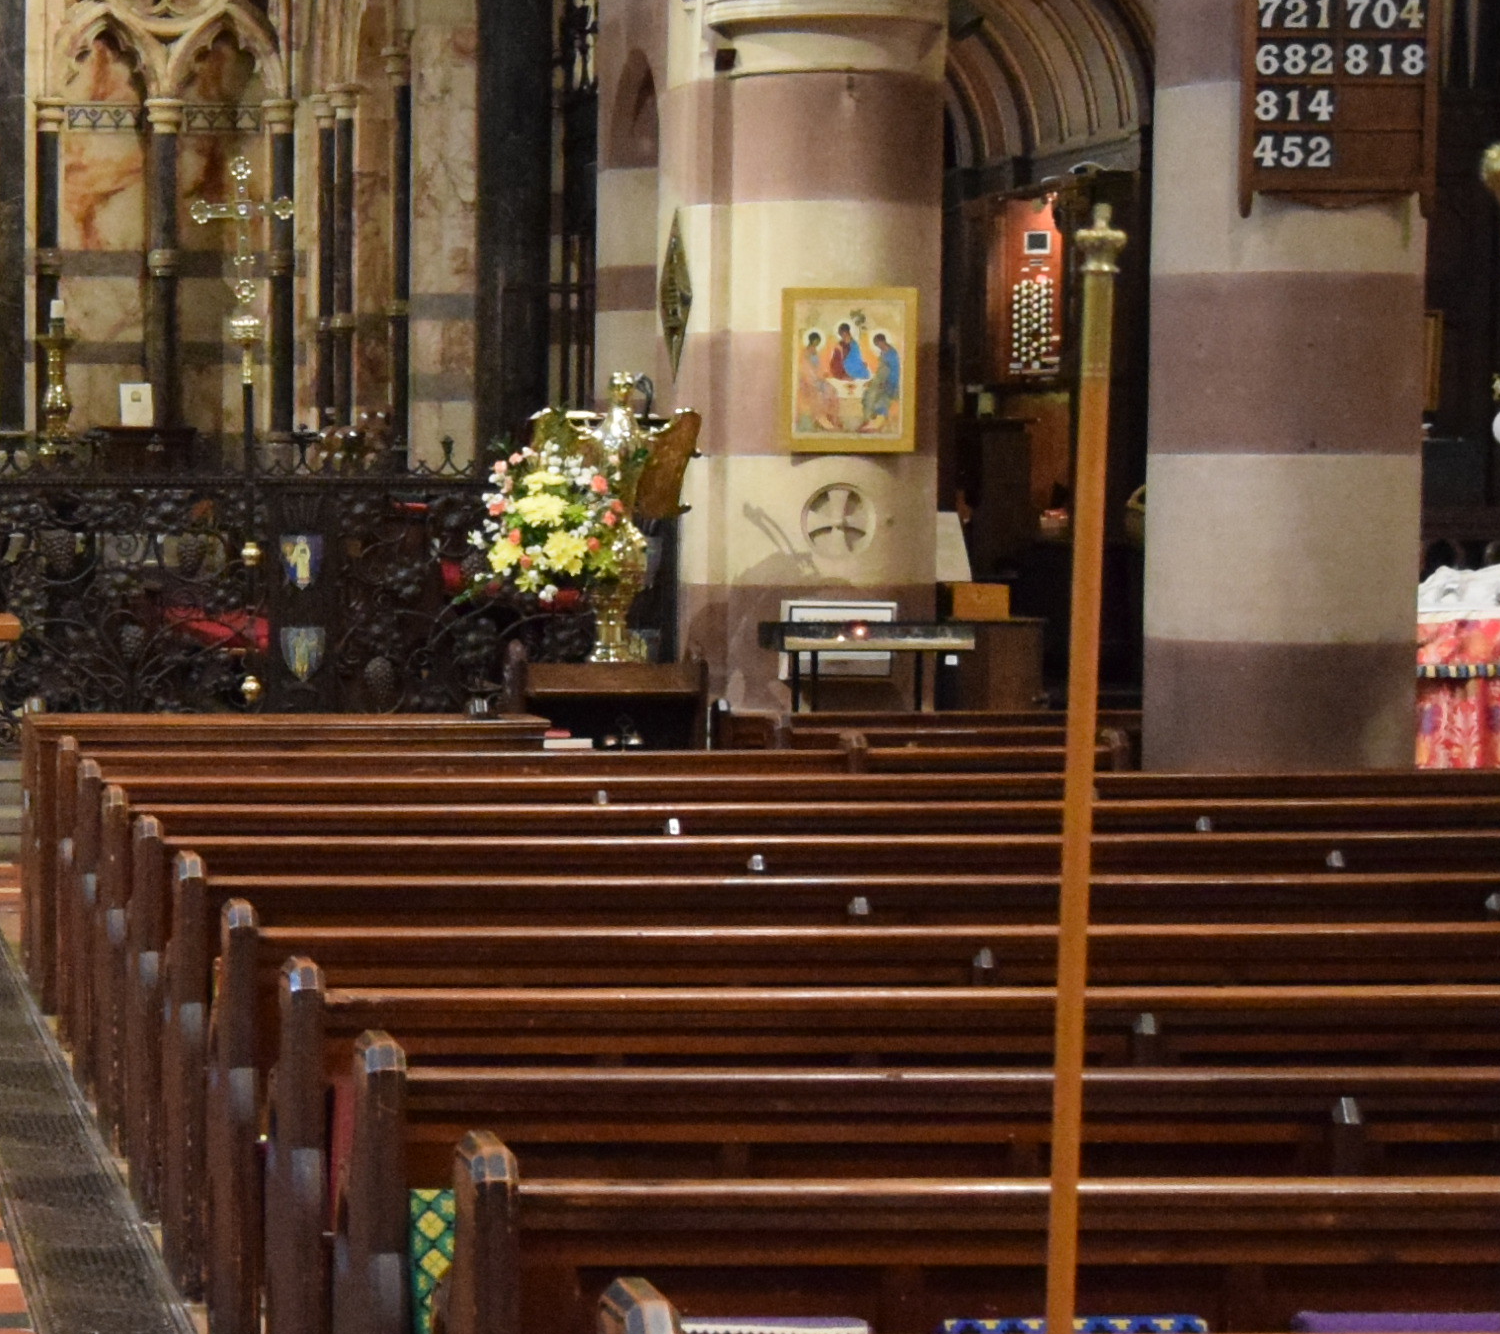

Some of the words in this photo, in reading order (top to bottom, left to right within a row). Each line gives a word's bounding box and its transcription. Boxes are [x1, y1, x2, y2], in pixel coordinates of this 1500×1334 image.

[1255, 43, 1334, 76] 682
[1344, 43, 1426, 76] 818
[1254, 89, 1334, 122] 814
[1253, 136, 1331, 167] 452
